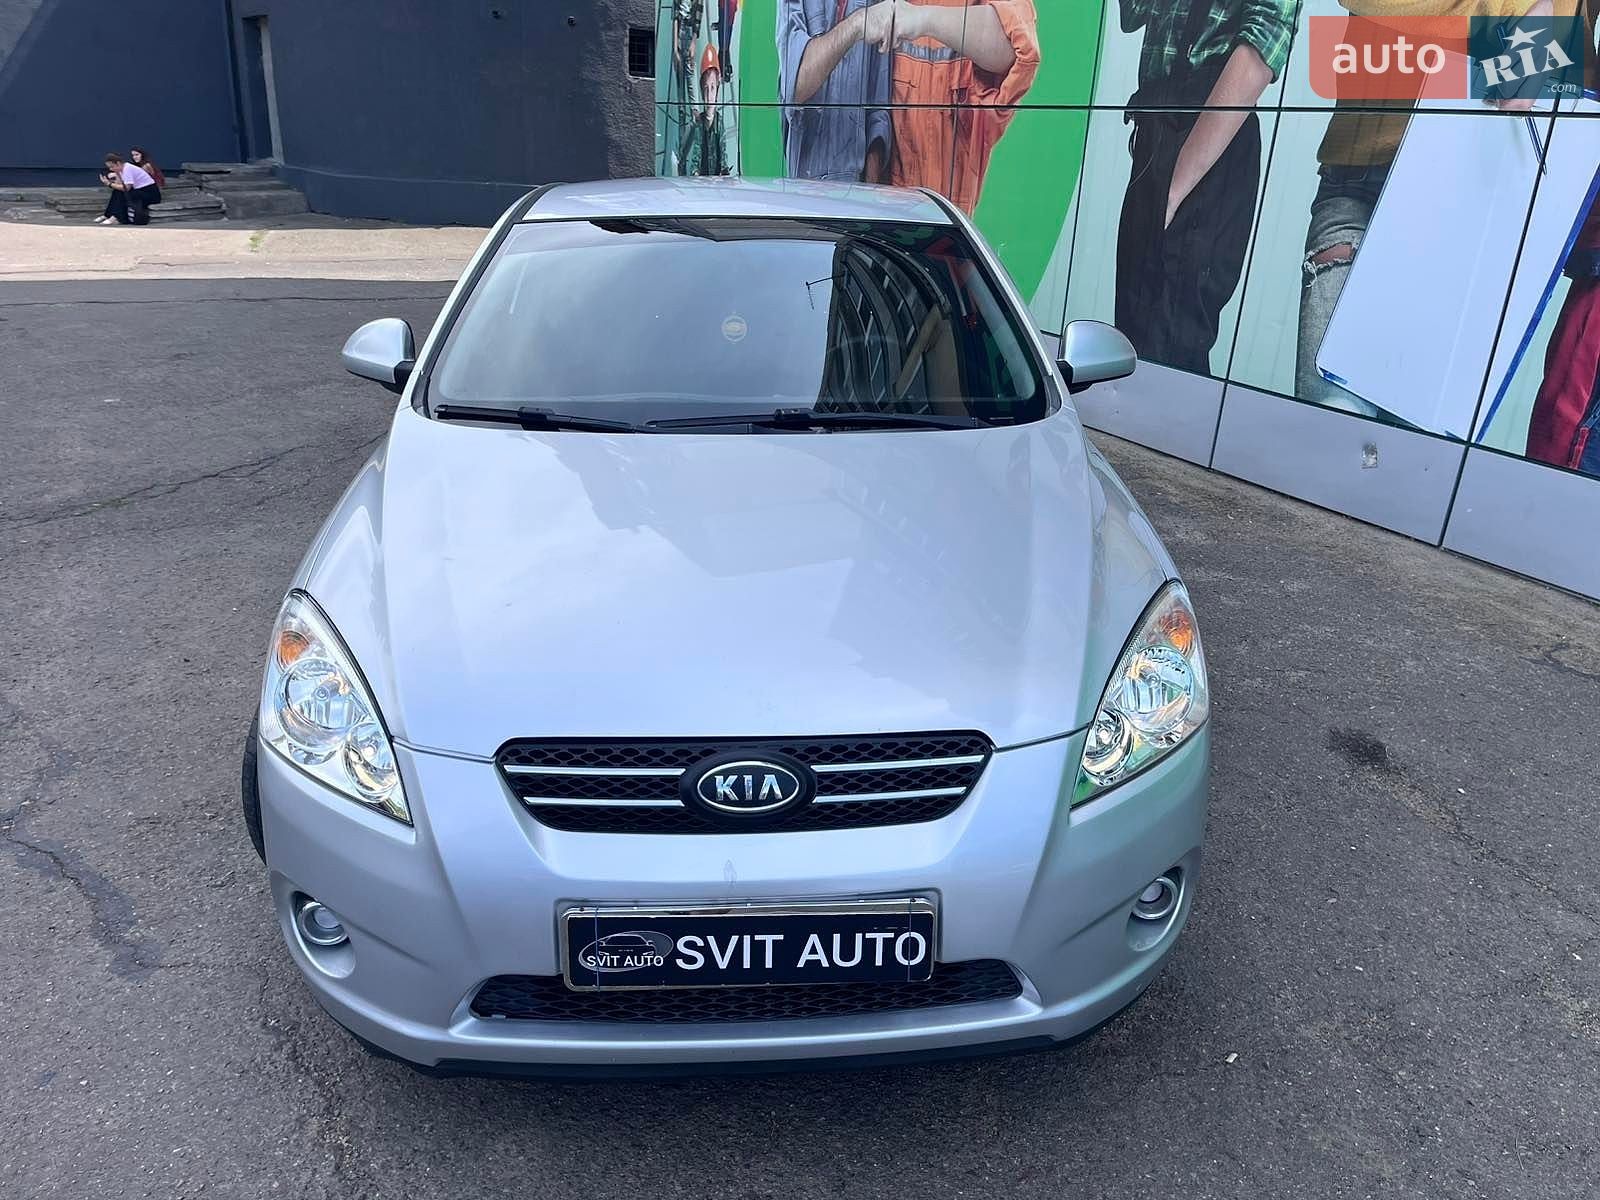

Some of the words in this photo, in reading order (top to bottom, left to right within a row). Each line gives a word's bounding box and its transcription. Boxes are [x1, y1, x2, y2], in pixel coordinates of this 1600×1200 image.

[715, 774, 784, 801] KIA
[586, 955, 620, 967] SVIT
[623, 955, 664, 967] AUTO
[675, 935, 784, 970] SVIT
[796, 932, 927, 968] AUTO
